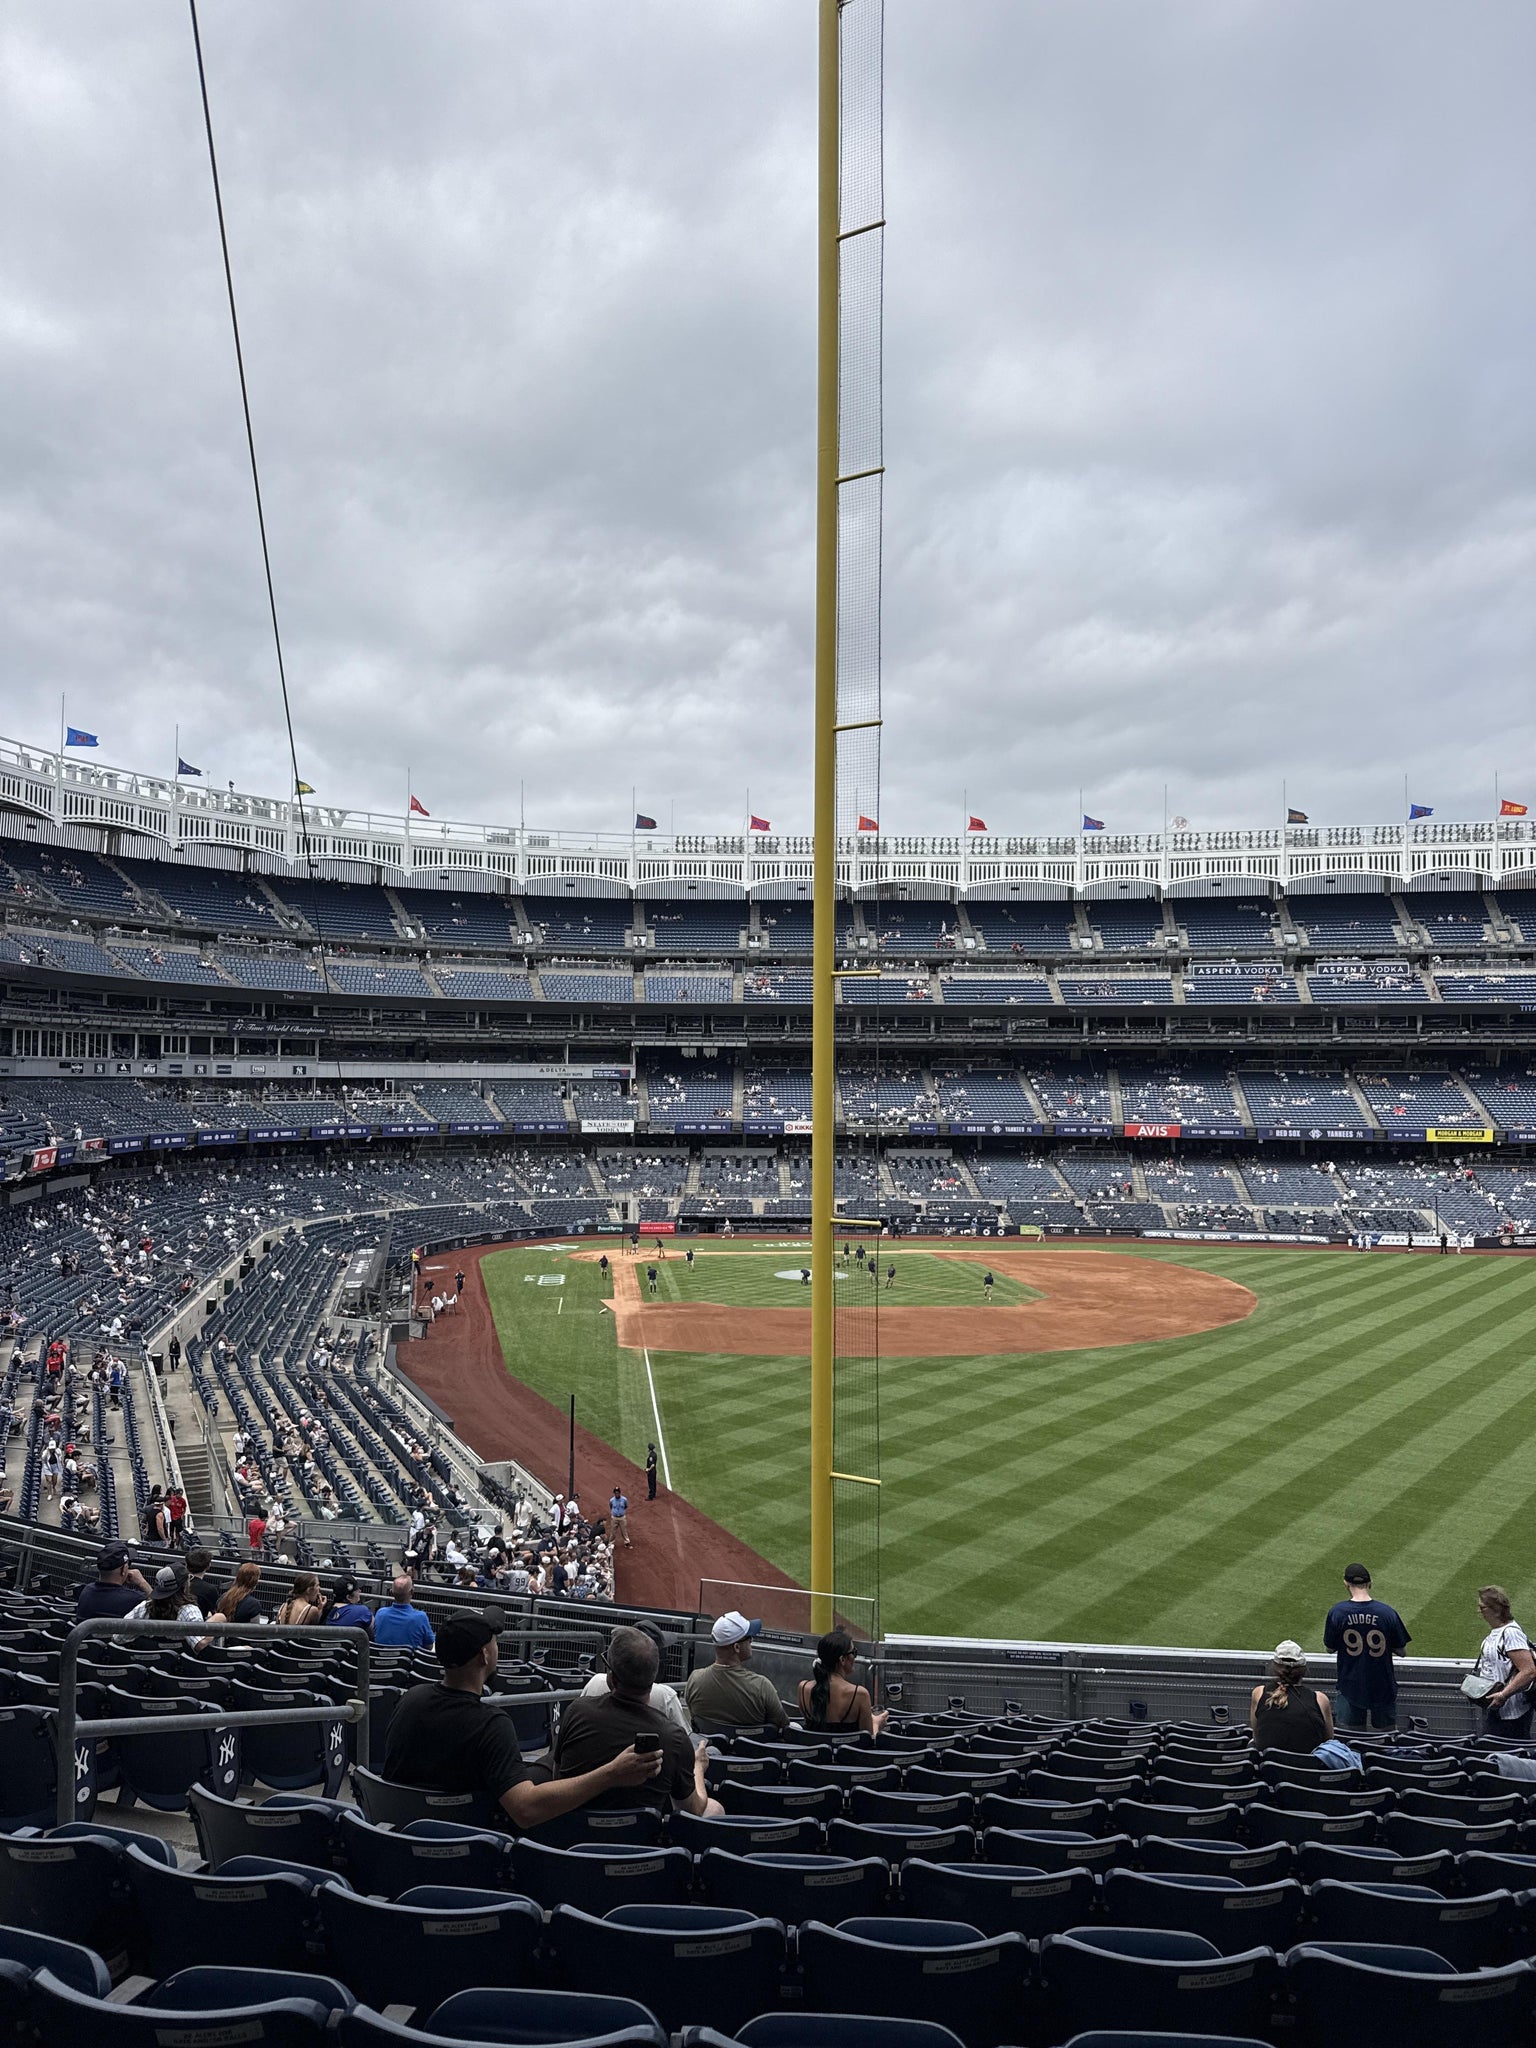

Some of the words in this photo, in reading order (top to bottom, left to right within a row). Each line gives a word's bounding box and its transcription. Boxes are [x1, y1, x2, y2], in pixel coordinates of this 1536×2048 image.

[266, 1024, 289, 1032] World
[290, 1025, 326, 1035] Champions
[1138, 1126, 1168, 1136] AVIS
[515, 1578, 526, 1586] 99
[1348, 1614, 1379, 1626] JUDGE
[1343, 1628, 1386, 1657] 99
[330, 1722, 342, 1750] NY
[218, 1734, 235, 1766] NY
